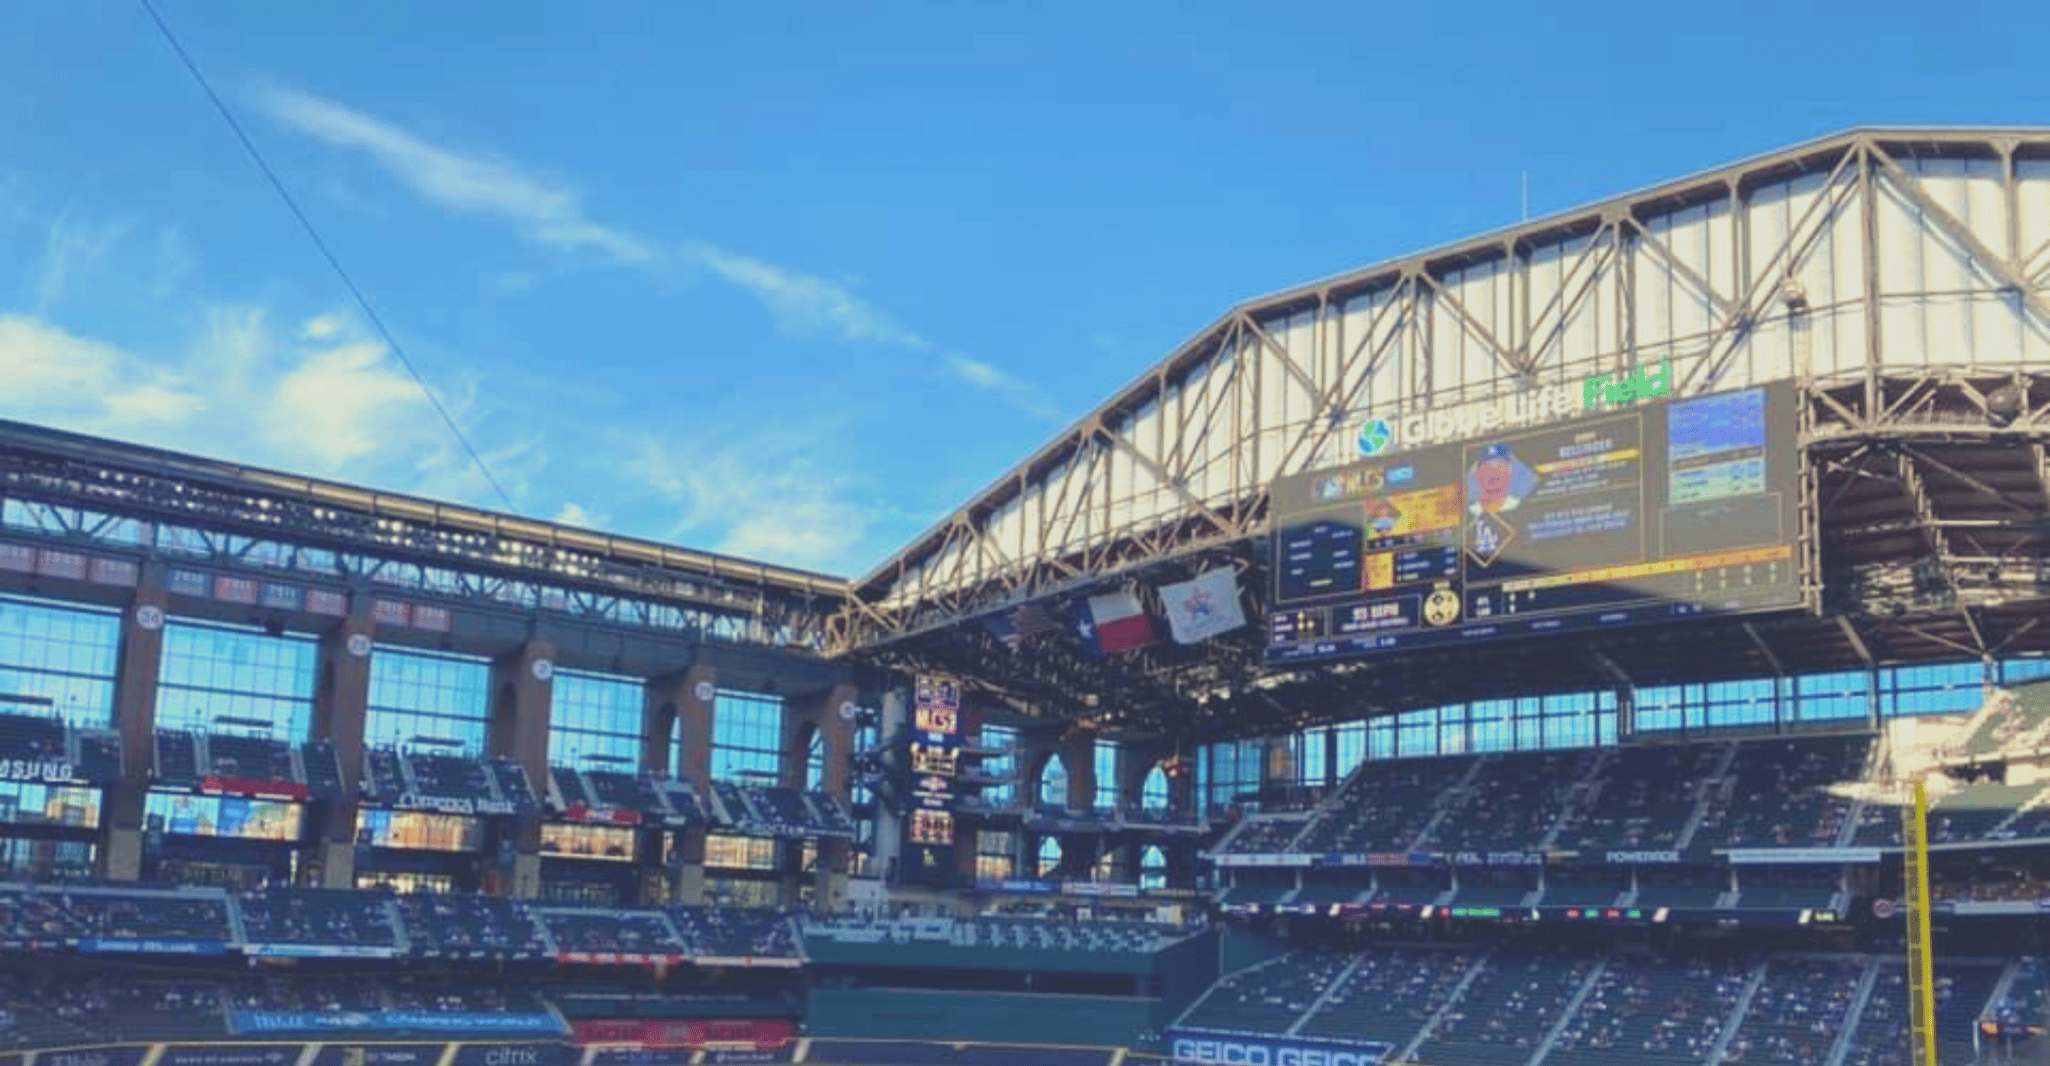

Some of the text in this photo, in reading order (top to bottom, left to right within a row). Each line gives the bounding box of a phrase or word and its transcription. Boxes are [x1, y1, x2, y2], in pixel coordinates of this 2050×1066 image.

[1401, 356, 1672, 444] Globe Life Field
[485, 1046, 538, 1066] citrix
[1175, 1039, 1269, 1066] GEICO
